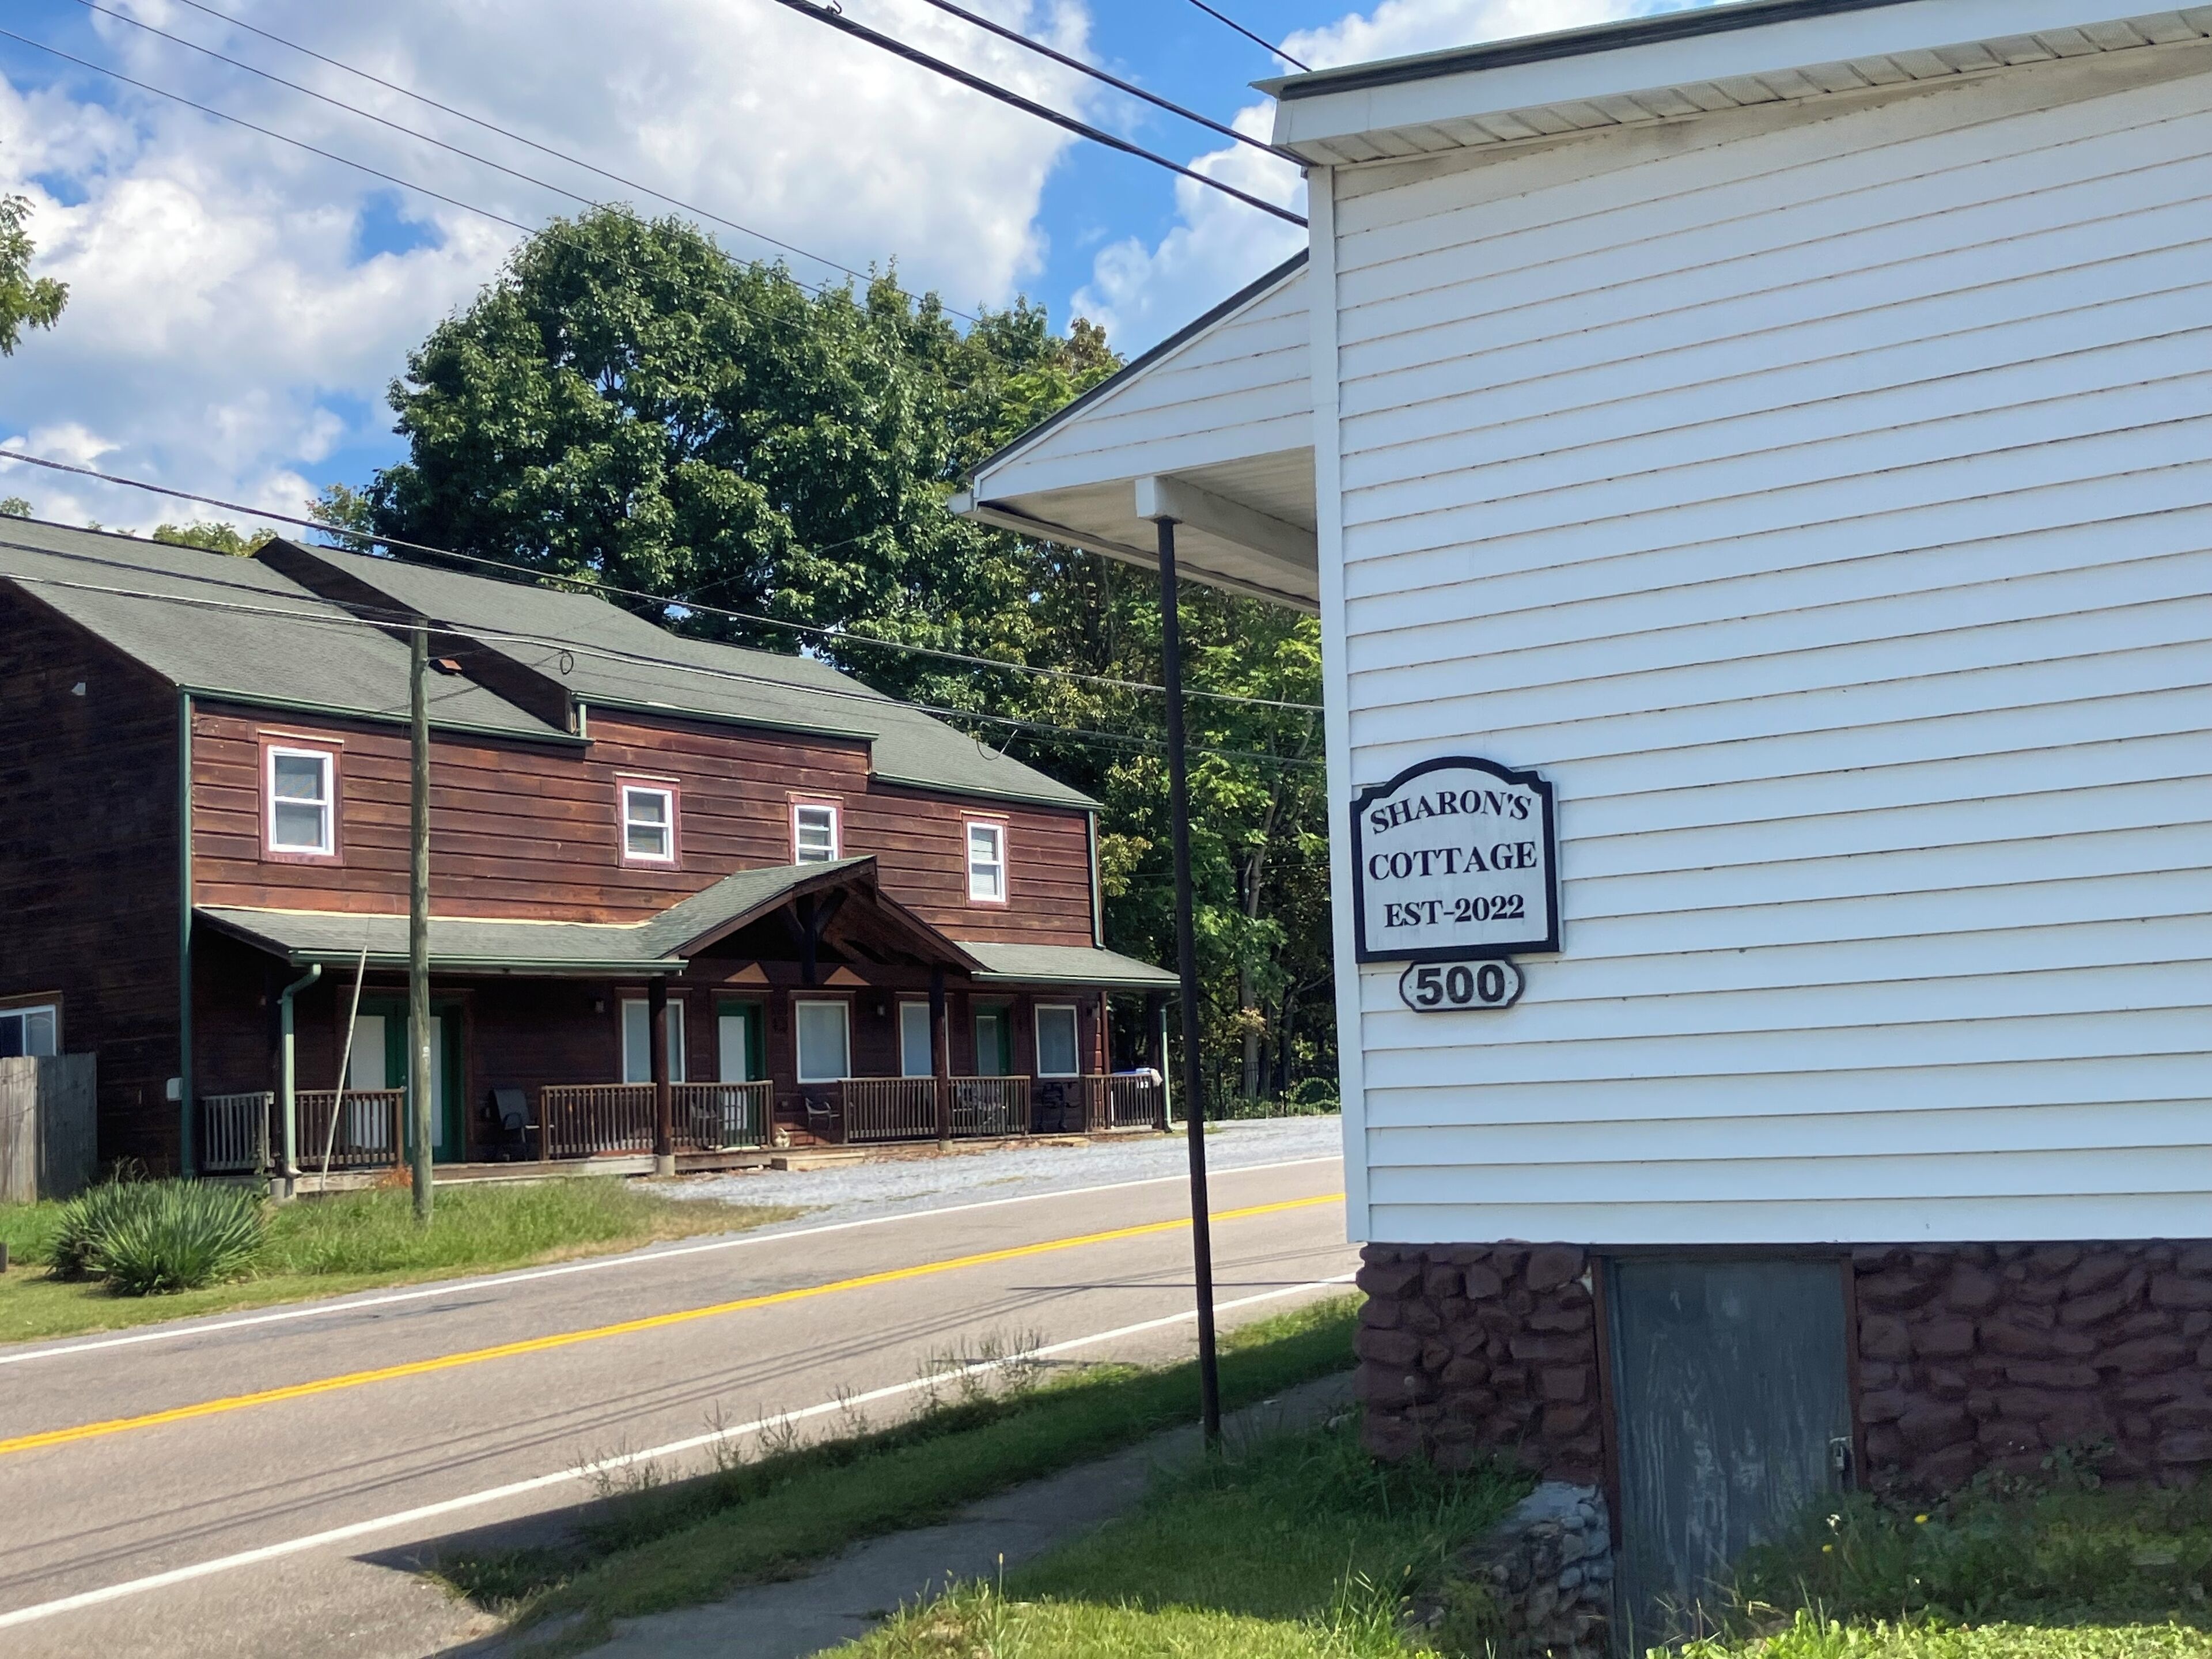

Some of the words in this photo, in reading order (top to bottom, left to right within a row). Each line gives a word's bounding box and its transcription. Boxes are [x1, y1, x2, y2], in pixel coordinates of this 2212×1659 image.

[1370, 790, 1531, 834] SHARON'S
[1369, 842, 1537, 880] COTTAGE
[1384, 894, 1524, 927] EST-2022
[1416, 964, 1505, 1005] 500
